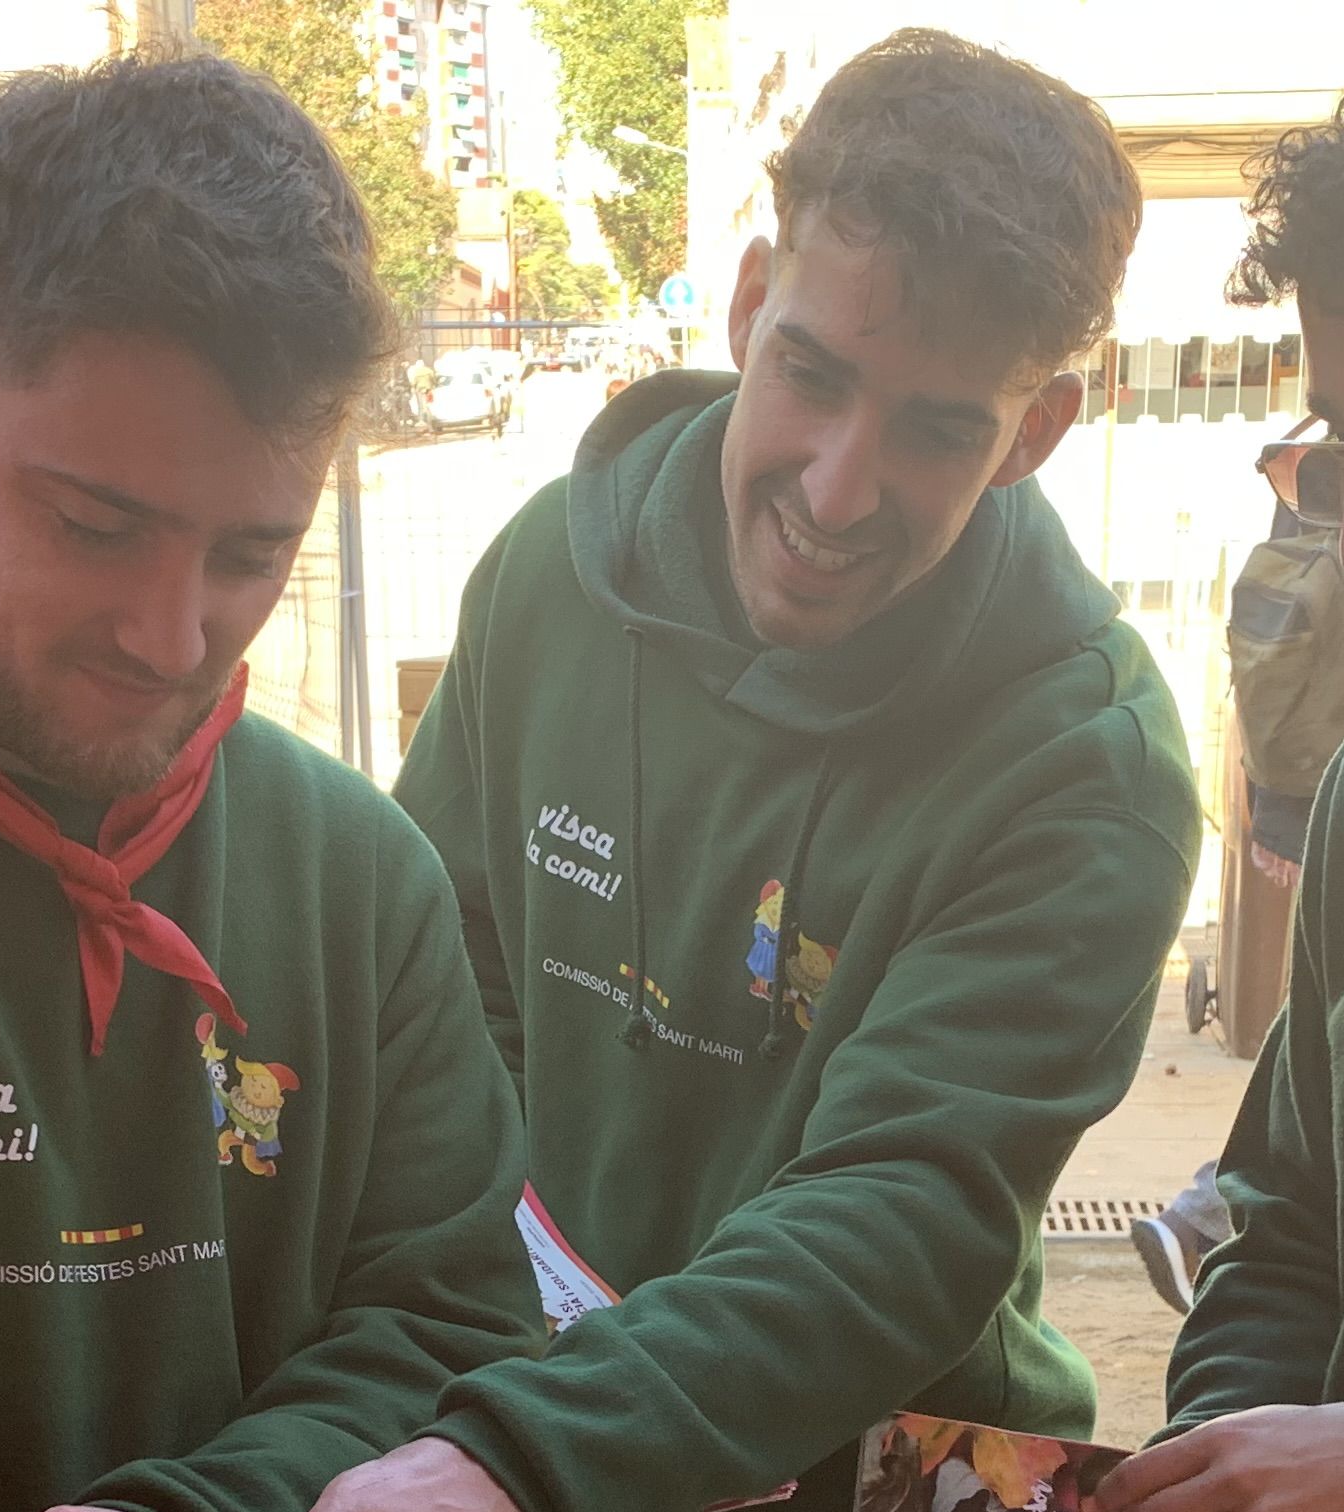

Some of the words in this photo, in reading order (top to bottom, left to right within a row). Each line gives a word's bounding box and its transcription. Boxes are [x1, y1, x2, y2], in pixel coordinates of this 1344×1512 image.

[539, 804, 615, 860] visca
[526, 829, 540, 865] la
[545, 854, 622, 901] comi!
[543, 959, 611, 996] COMISSIÓ
[656, 1024, 696, 1049] SANT
[138, 1244, 187, 1272] SANT
